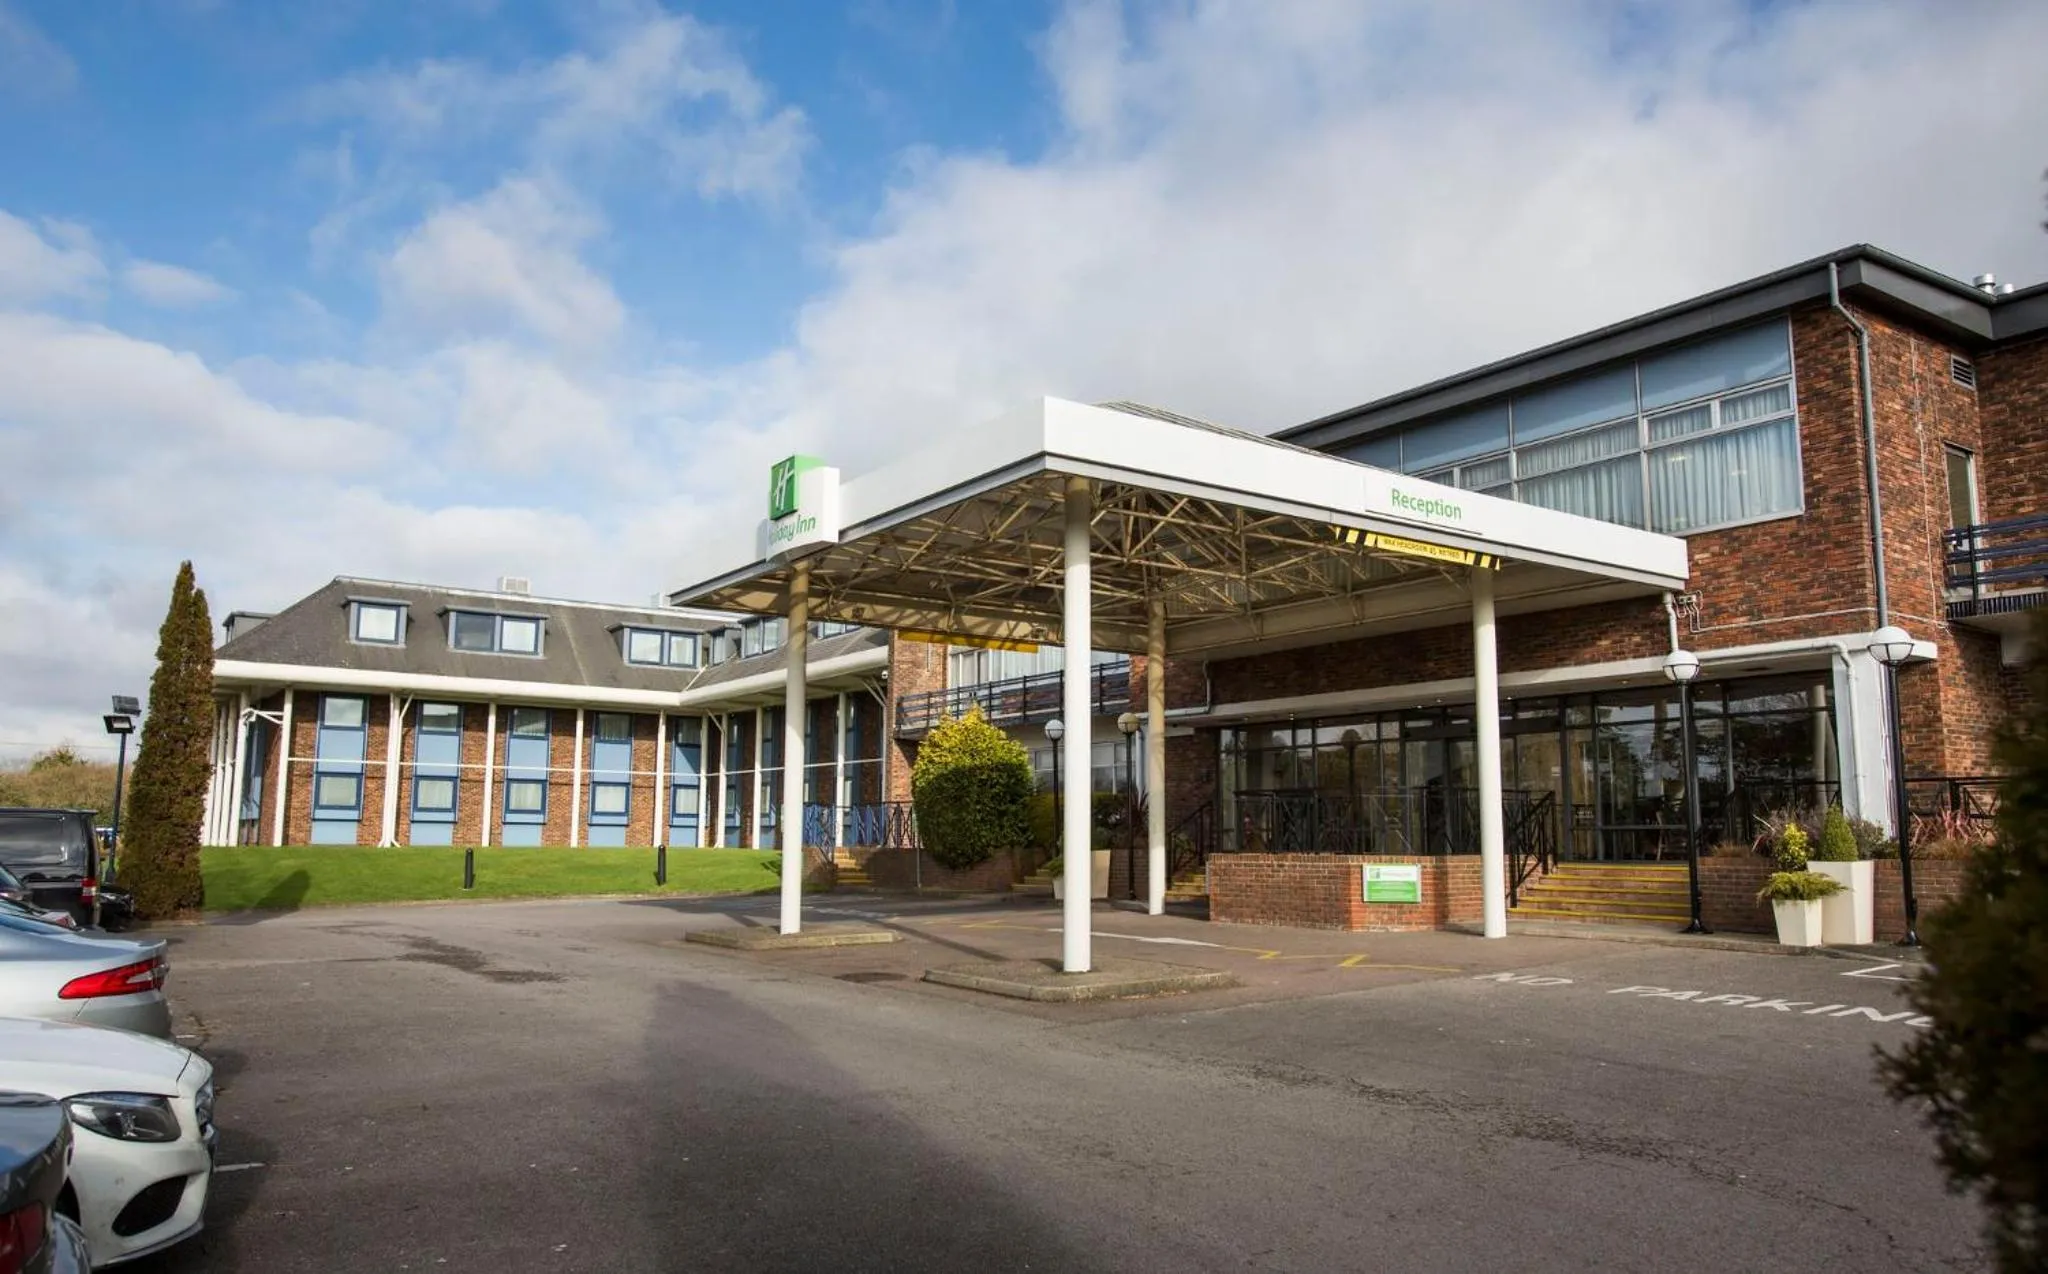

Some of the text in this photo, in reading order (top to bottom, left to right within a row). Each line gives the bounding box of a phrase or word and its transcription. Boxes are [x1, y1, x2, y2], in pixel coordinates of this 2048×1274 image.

[1391, 488, 1463, 520] Reception
[768, 514, 817, 546] iday Inn
[1471, 972, 1573, 986] NO
